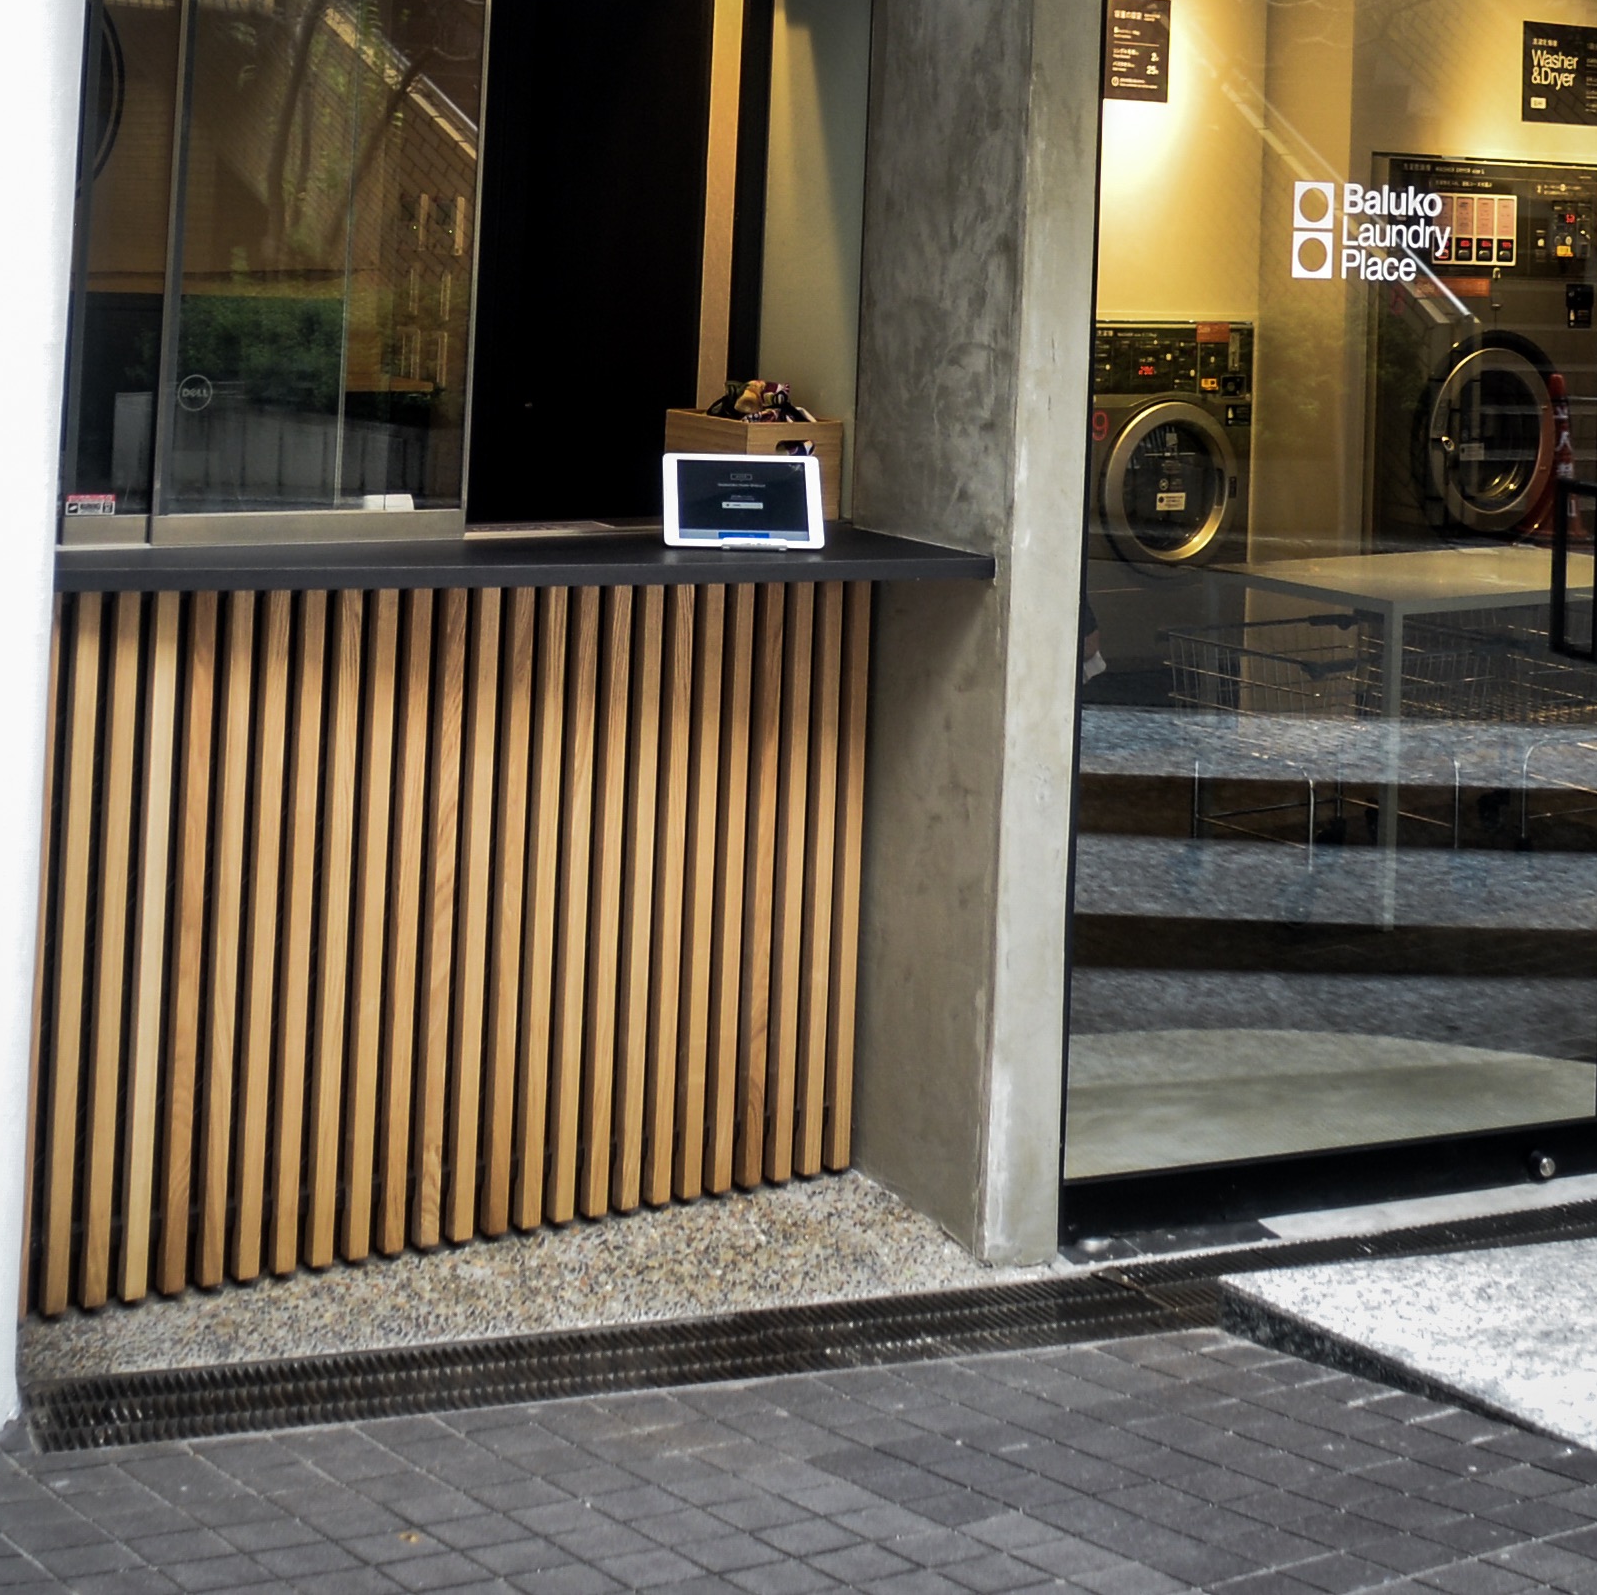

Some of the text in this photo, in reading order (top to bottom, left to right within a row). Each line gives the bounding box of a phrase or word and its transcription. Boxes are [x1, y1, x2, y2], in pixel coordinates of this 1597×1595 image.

[1531, 48, 1579, 70] Washer
[1531, 66, 1575, 91] &Dryer
[1343, 183, 1443, 217] Baluko
[1342, 215, 1451, 257] Laundry
[1341, 248, 1417, 282] Place
